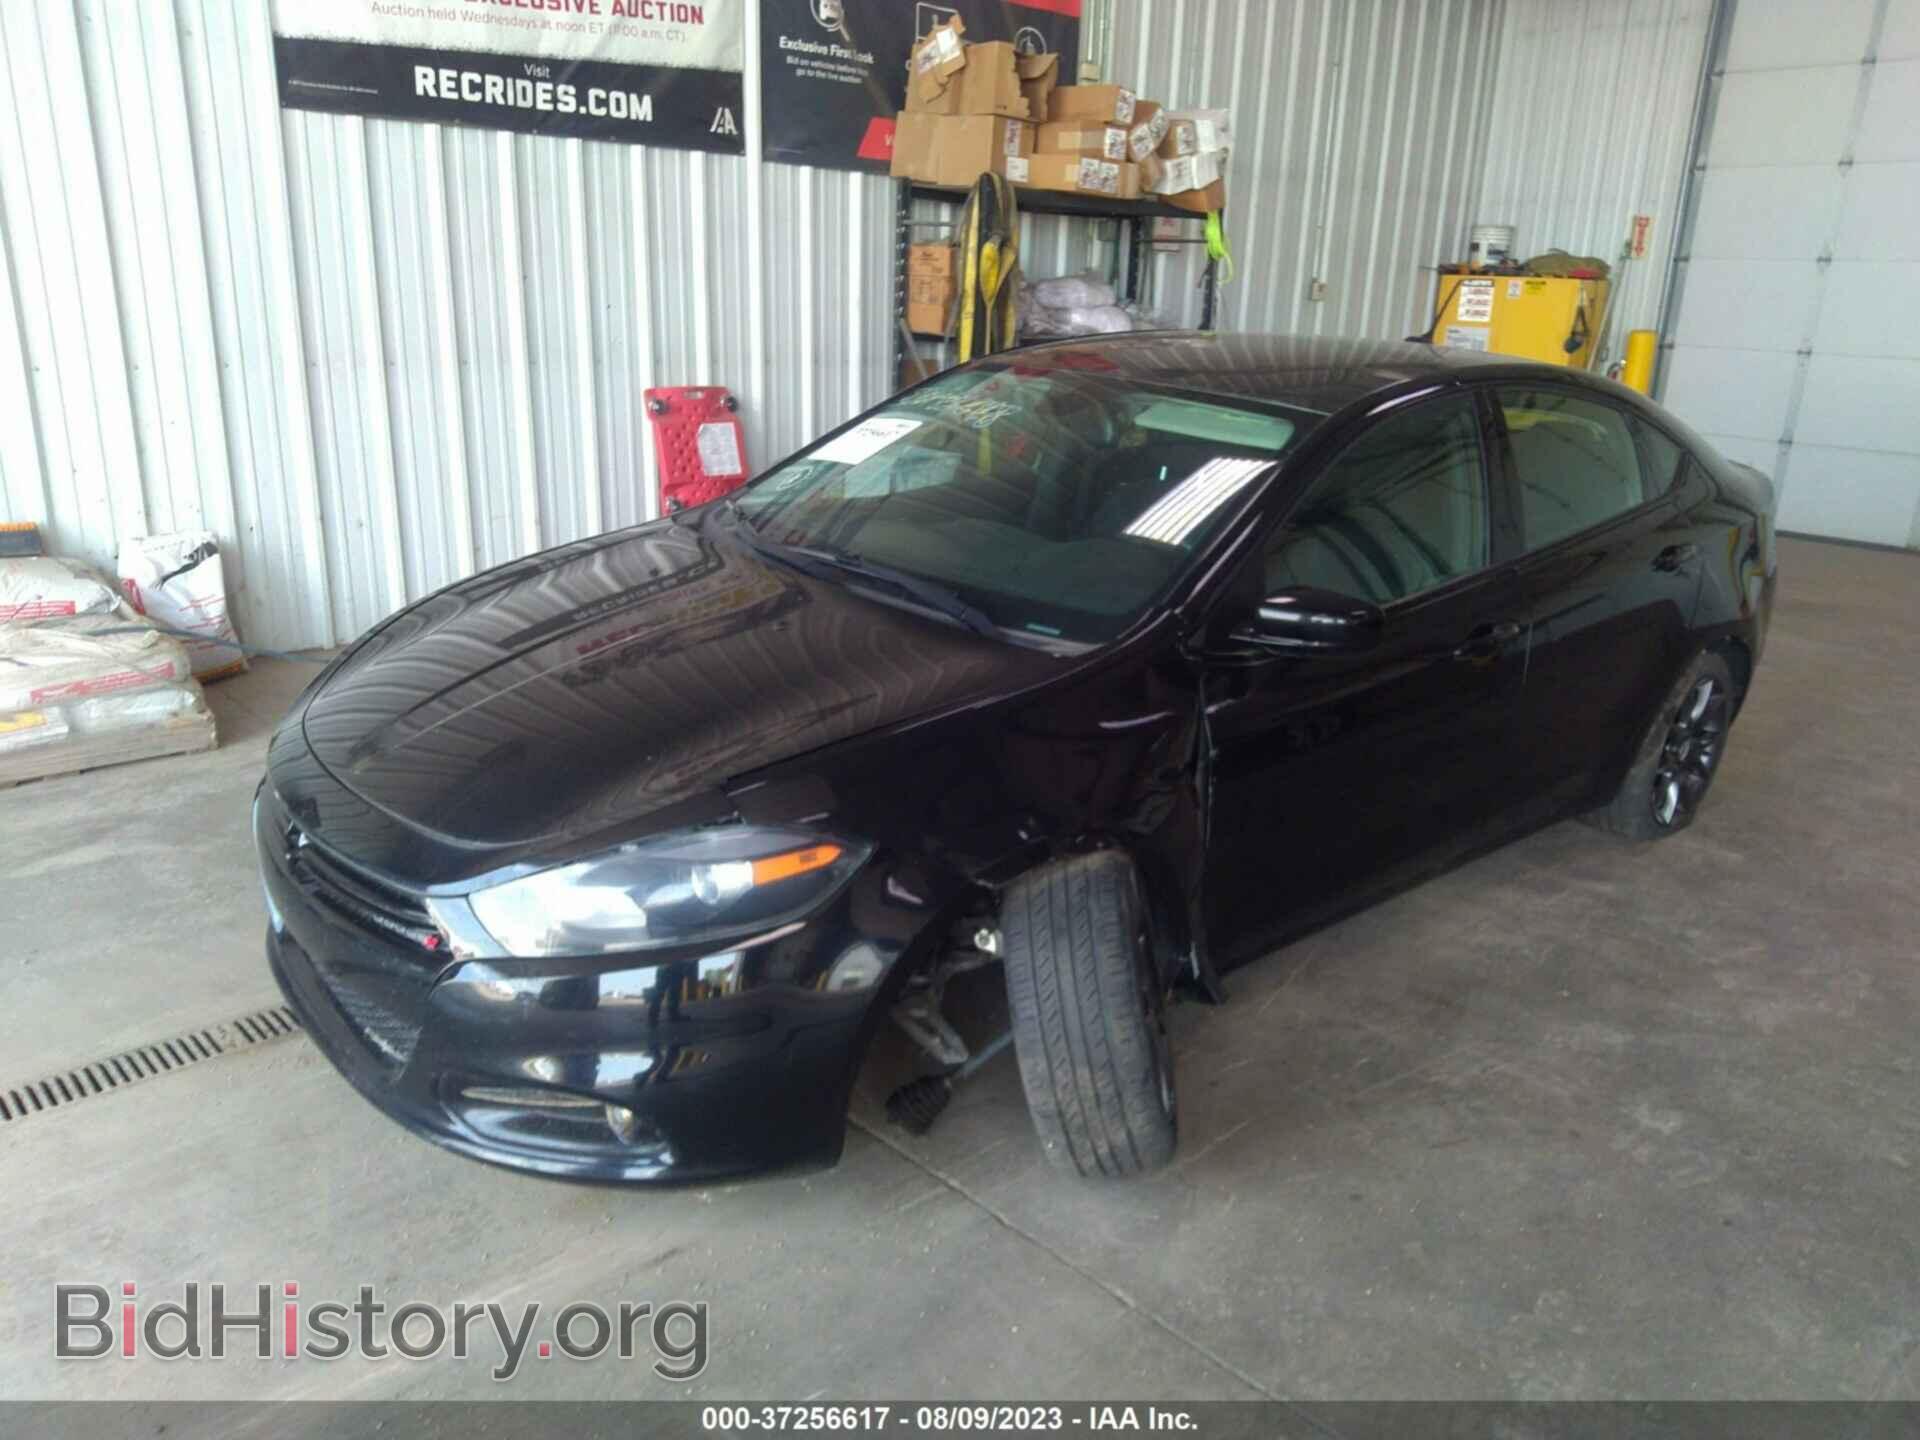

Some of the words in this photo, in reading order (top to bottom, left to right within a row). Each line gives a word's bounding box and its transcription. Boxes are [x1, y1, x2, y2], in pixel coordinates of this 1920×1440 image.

[371, 1, 426, 18] Auction
[427, 7, 457, 21] held
[460, 9, 538, 30] Wednesdays
[540, 19, 553, 30] at
[556, 21, 586, 33] noon
[589, 22, 605, 34] ET
[665, 28, 686, 43] CT)
[612, 0, 705, 25] AUCTION
[779, 35, 829, 56] Exclusive
[524, 63, 551, 79] Visit
[414, 65, 653, 122] RECRIDES.COM
